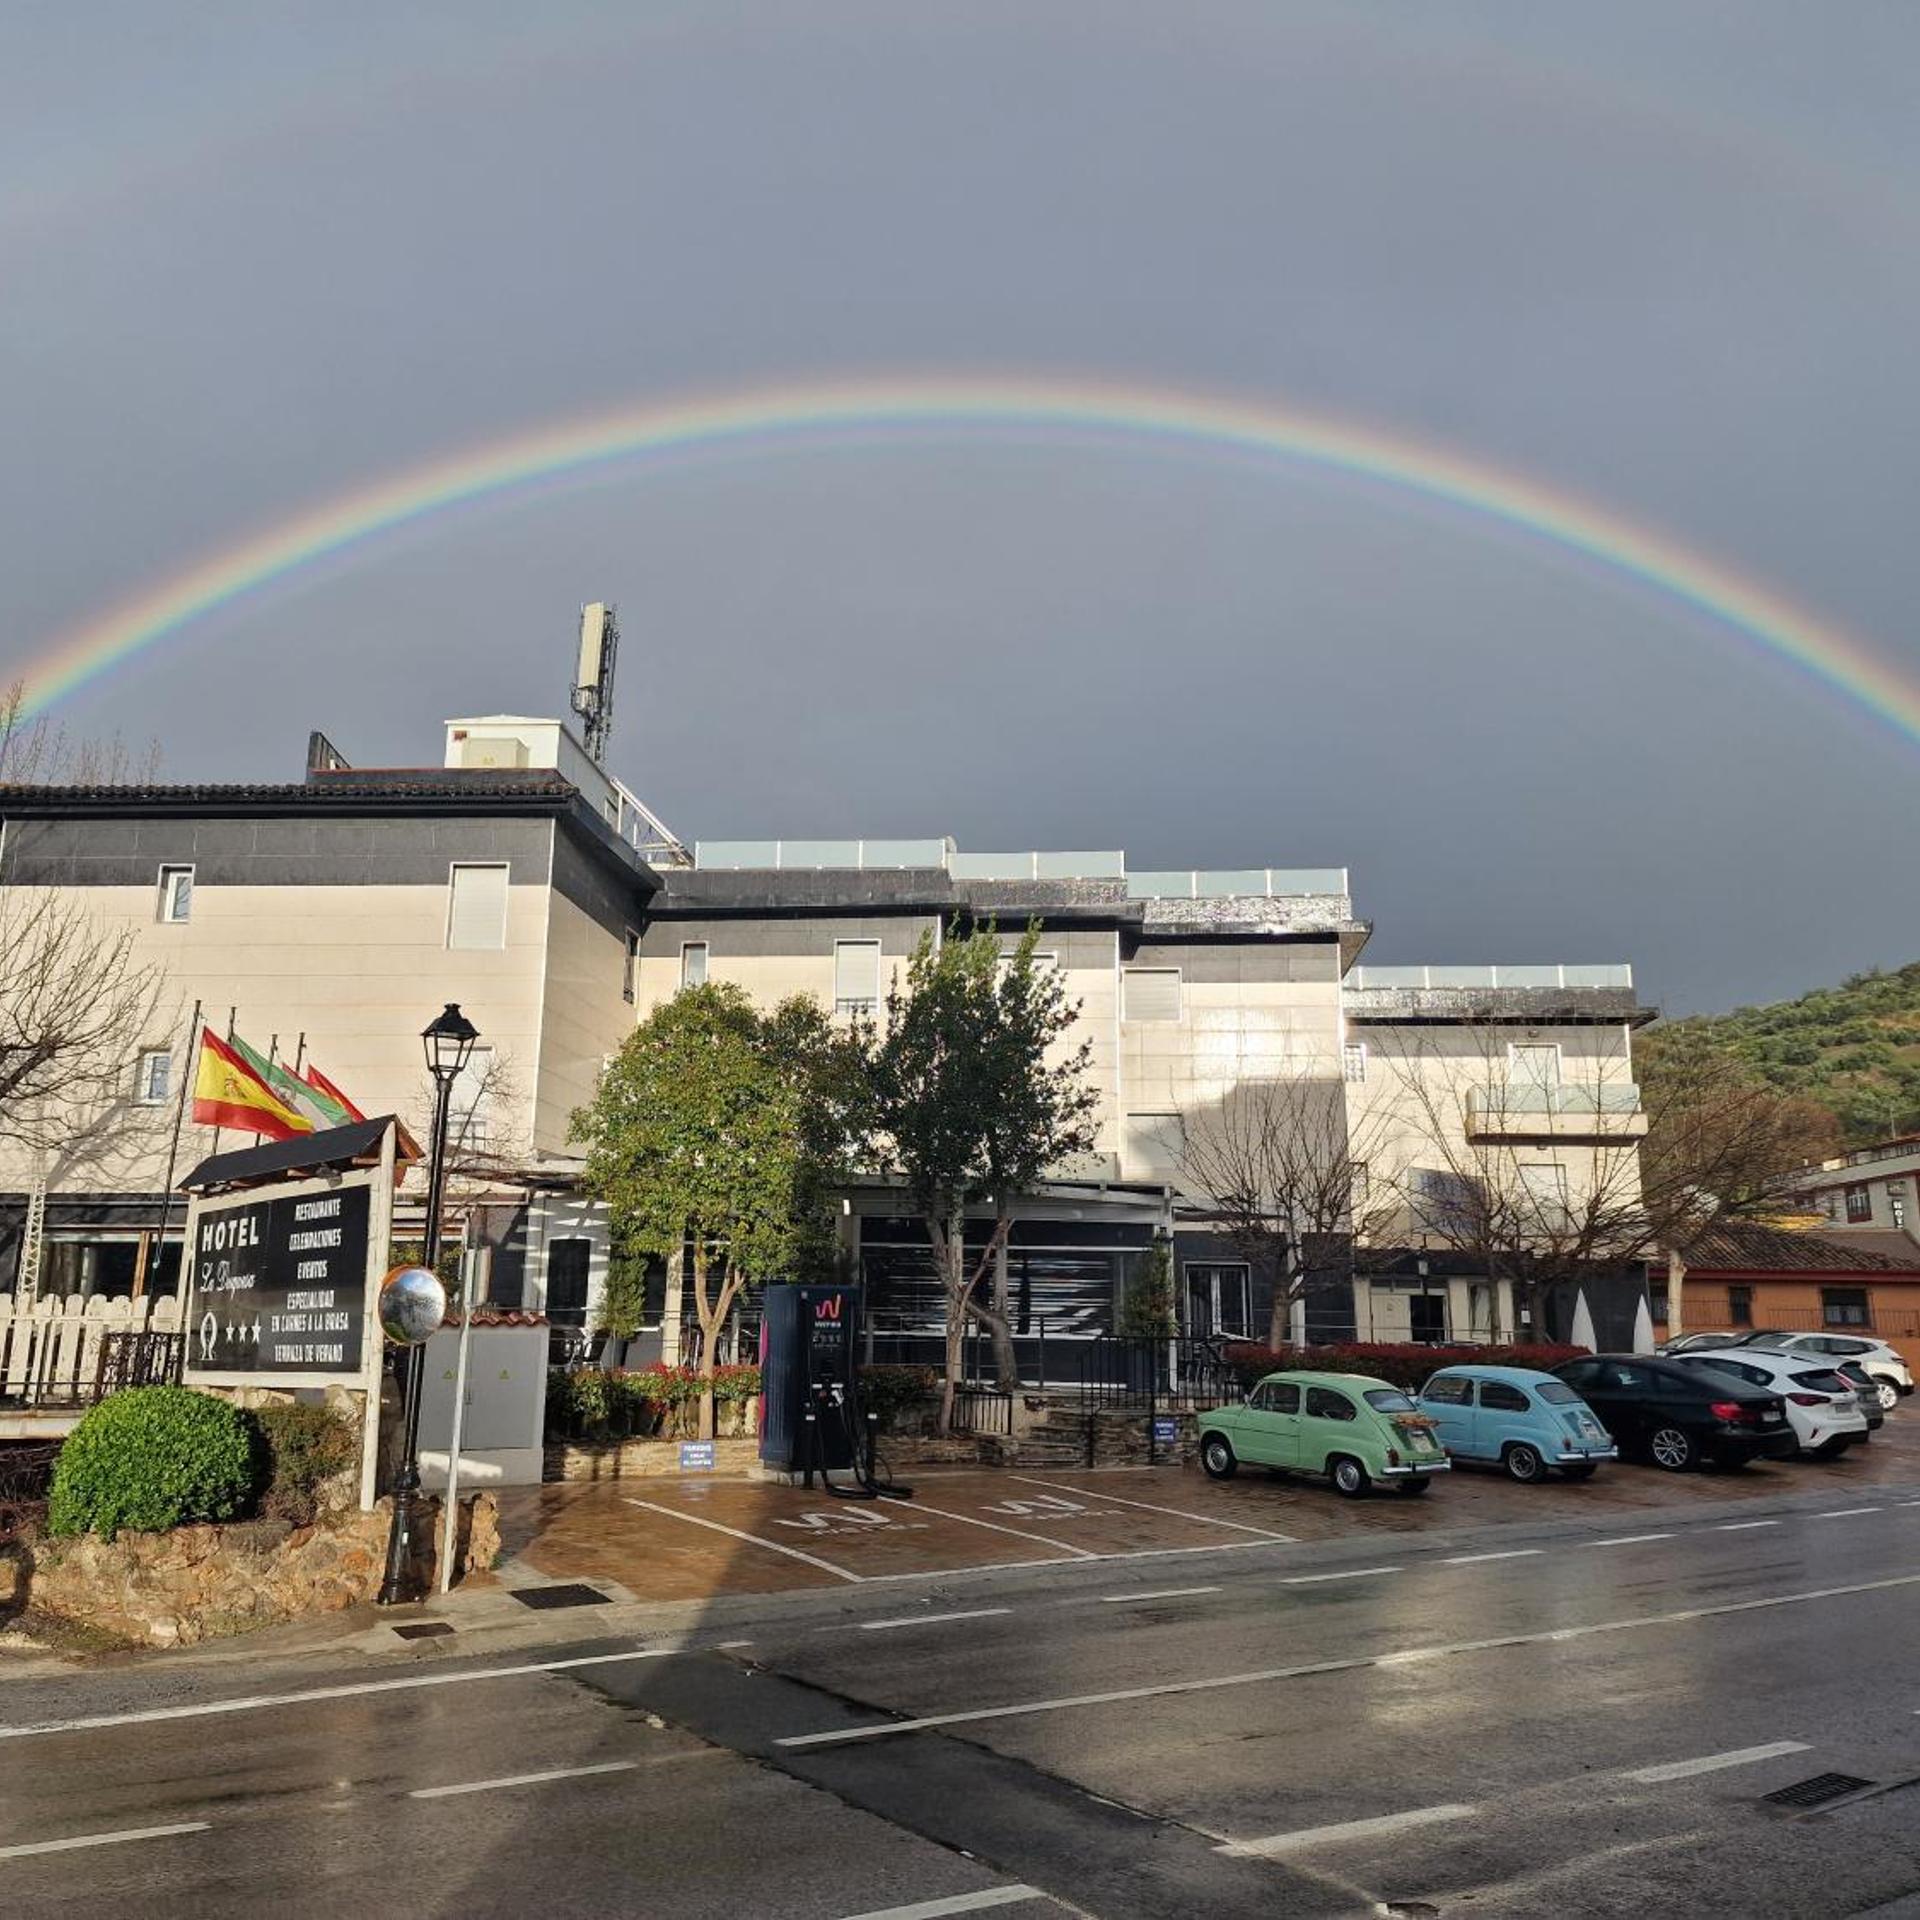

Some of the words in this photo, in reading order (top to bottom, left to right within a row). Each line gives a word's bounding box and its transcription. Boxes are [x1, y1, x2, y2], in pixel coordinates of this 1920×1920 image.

[294, 1198, 342, 1222] RESTAURANTE
[201, 1216, 260, 1253] HOTEL
[288, 1228, 342, 1252] CELEBRACIONES
[297, 1260, 328, 1280] EVENTOS
[286, 1289, 335, 1310] ESPECIALIDAD
[271, 1315, 280, 1333] EN
[280, 1314, 307, 1333] CARNES
[314, 1313, 323, 1331] LA
[324, 1312, 349, 1331] BRASA
[274, 1343, 303, 1363] TERRAZA
[304, 1343, 314, 1363] DE
[314, 1343, 343, 1363] VERANO
